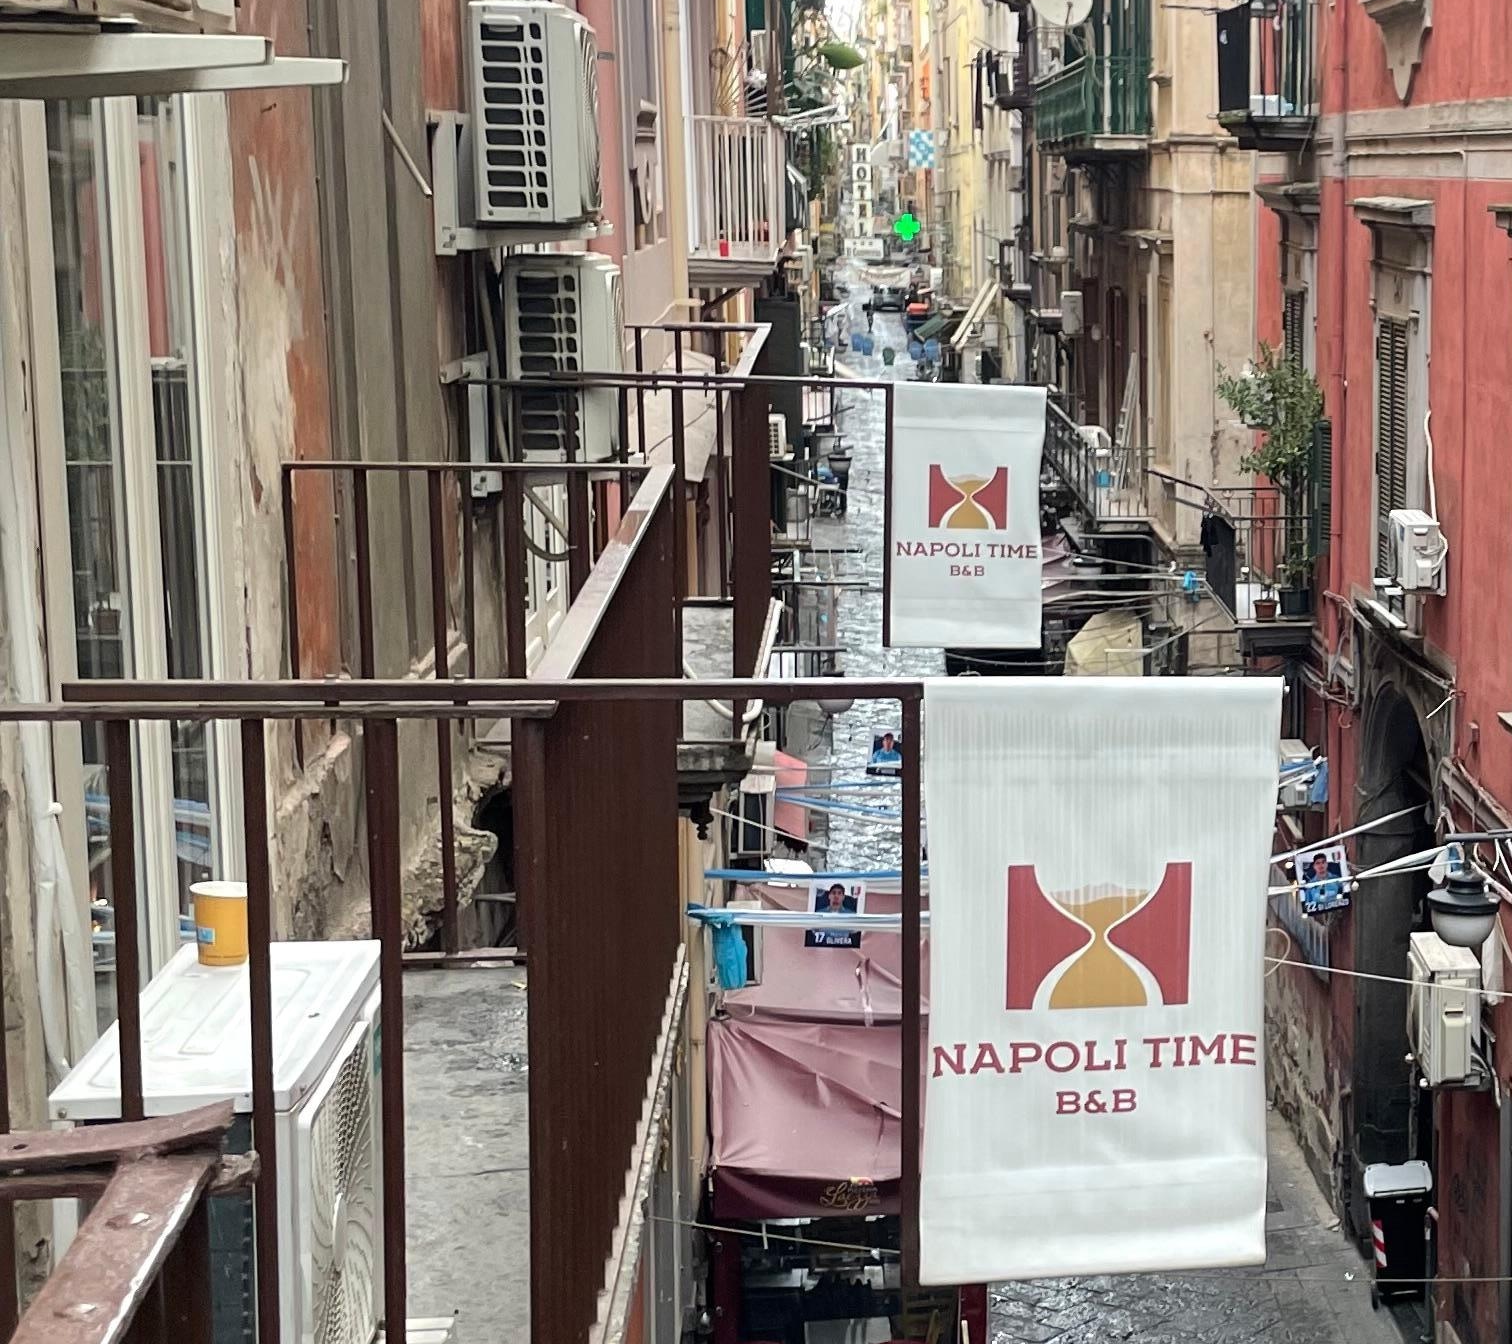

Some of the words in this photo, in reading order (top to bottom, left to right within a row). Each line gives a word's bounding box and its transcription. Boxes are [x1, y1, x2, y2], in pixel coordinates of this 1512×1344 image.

[896, 541, 981, 557] NAPOLI
[987, 543, 1038, 559] TIME
[950, 565, 985, 577] B&B
[814, 931, 826, 943] 17
[932, 1038, 1128, 1078] NAPOLI
[1143, 1033, 1257, 1068] TIME
[1056, 1089, 1137, 1115] B&B
